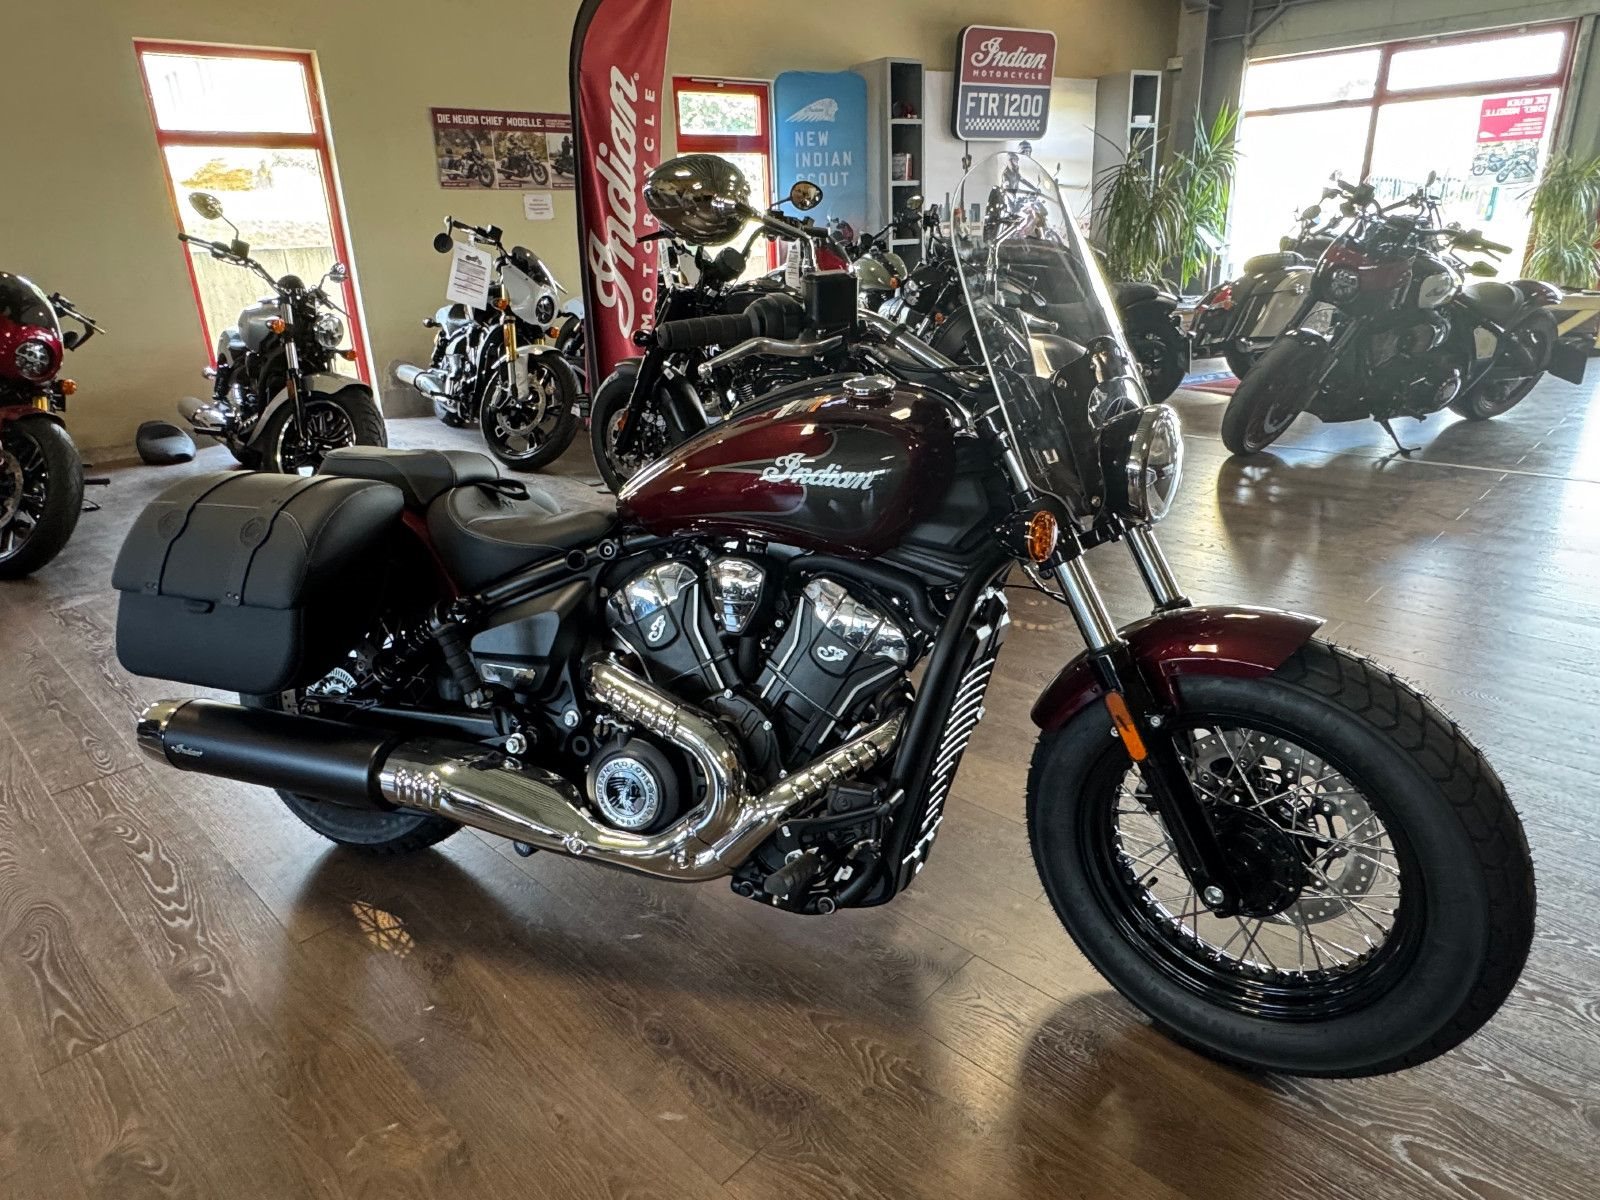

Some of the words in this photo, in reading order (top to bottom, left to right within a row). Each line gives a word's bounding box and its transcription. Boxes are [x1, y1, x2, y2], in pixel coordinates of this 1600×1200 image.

[970, 37, 1047, 69] Indian
[972, 70, 1043, 80] MOTORCYCLE
[965, 92, 998, 116] FTR
[1003, 94, 1043, 117] 1200
[437, 114, 451, 124] DIE
[452, 114, 479, 125] NEUEN
[481, 116, 504, 126] CHIEF
[795, 131, 829, 147] NEW
[795, 151, 852, 168] INDIAN
[589, 66, 637, 339] Indian
[641, 88, 656, 331] MOTORYCLE
[760, 453, 877, 490] Indian
